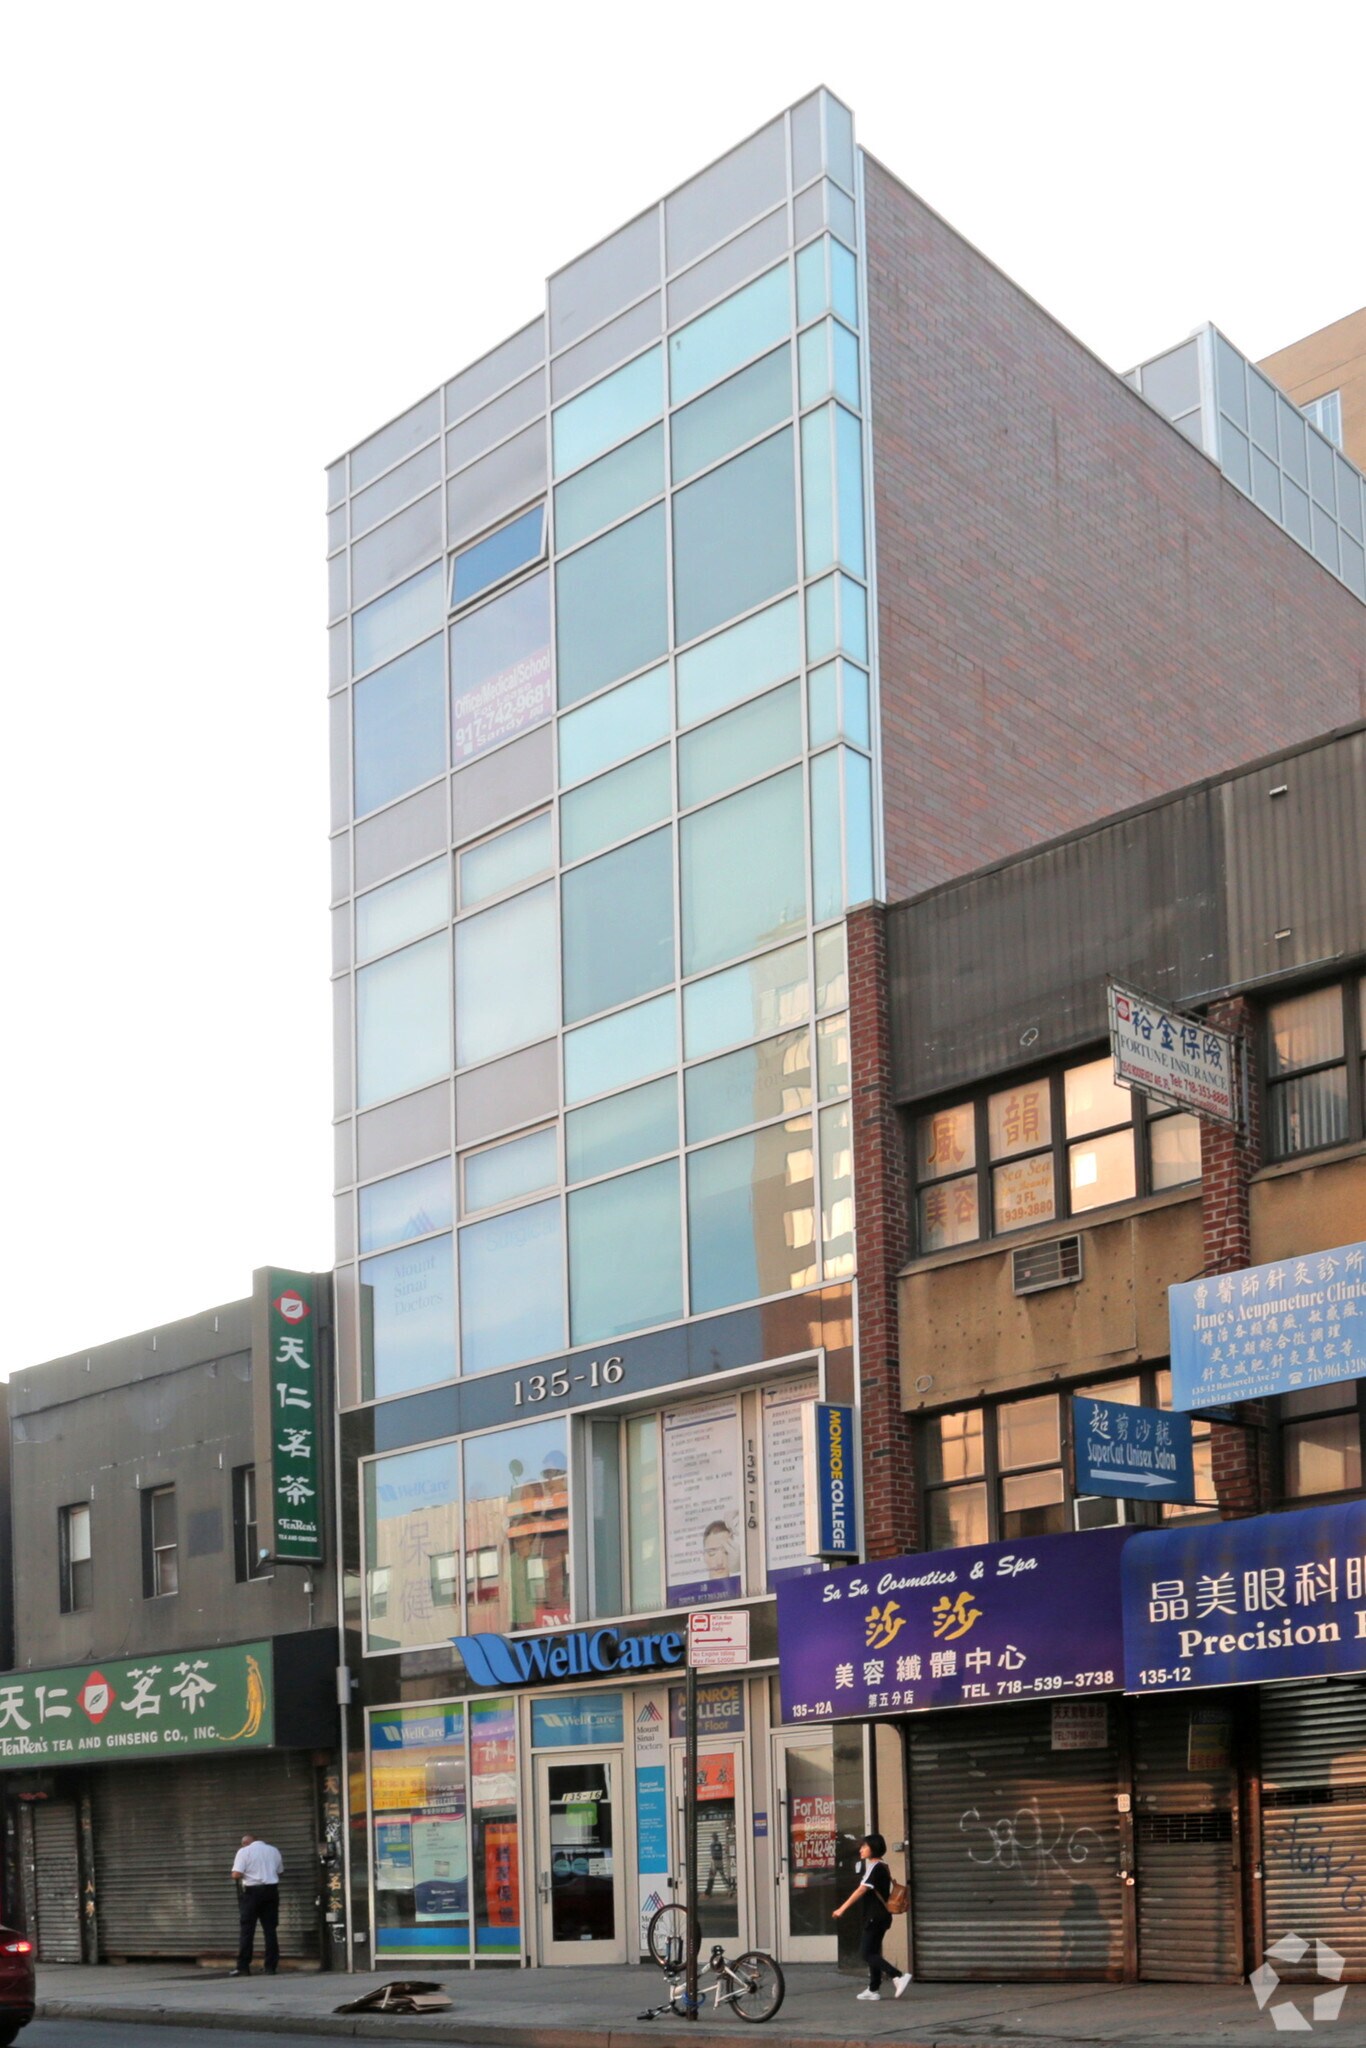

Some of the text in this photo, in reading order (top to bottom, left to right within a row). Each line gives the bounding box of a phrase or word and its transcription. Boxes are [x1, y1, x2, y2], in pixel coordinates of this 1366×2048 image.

[456, 679, 551, 746] 917-742-9681
[477, 714, 525, 747] Sandy
[1120, 1034, 1228, 1090] FORTUNE INSURANCE
[927, 1181, 974, 1232] 美容
[1024, 1192, 1036, 1202] FL
[393, 1255, 436, 1280] Mount
[394, 1274, 428, 1297] Sinai
[395, 1295, 443, 1316] Doctors
[1237, 1290, 1325, 1321] Acupuncture
[1327, 1278, 1366, 1302] Clinic
[514, 1357, 624, 1407] 135-16
[1216, 1375, 1254, 1390] Roosevelt
[1191, 1393, 1232, 1407] Flushing
[1234, 1388, 1248, 1398] NY
[276, 1336, 315, 1506] 天仁茗茶
[1126, 1443, 1153, 1468] Unisex
[1154, 1445, 1177, 1471] Salon
[398, 1479, 449, 1497] WellCare
[823, 1555, 1038, 1603] Sa Sa Cosmetics & Spa
[1178, 1617, 1341, 1659] Precision
[513, 1628, 682, 1679] WellCare
[835, 1644, 1026, 1690] 美容纖體中心
[1139, 1666, 1191, 1685] 135-12
[120, 1660, 217, 1719] 茗茶
[962, 1670, 1114, 1699] TEL 718-539-3738
[678, 1686, 739, 1706] MNROE
[868, 1690, 914, 1708] 第五分店
[562, 1713, 616, 1727] WellCare
[678, 1700, 740, 1722] CLLEGE
[792, 1701, 833, 1718] 135-12A
[401, 1724, 444, 1741] WellCare
[637, 1725, 659, 1734] Mount
[704, 1720, 729, 1731] Floor
[53, 1740, 73, 1751] TEA
[78, 1737, 101, 1749] AND
[106, 1731, 158, 1747] GINSENG
[163, 1729, 188, 1743] CO.,
[194, 1726, 220, 1739] INC.
[637, 1734, 655, 1742] Sinai
[637, 1743, 663, 1751] Doctors
[793, 1798, 812, 1816] For
[804, 1815, 831, 1825] Office
[804, 1832, 831, 1841] School
[806, 1858, 826, 1867] Sandy
